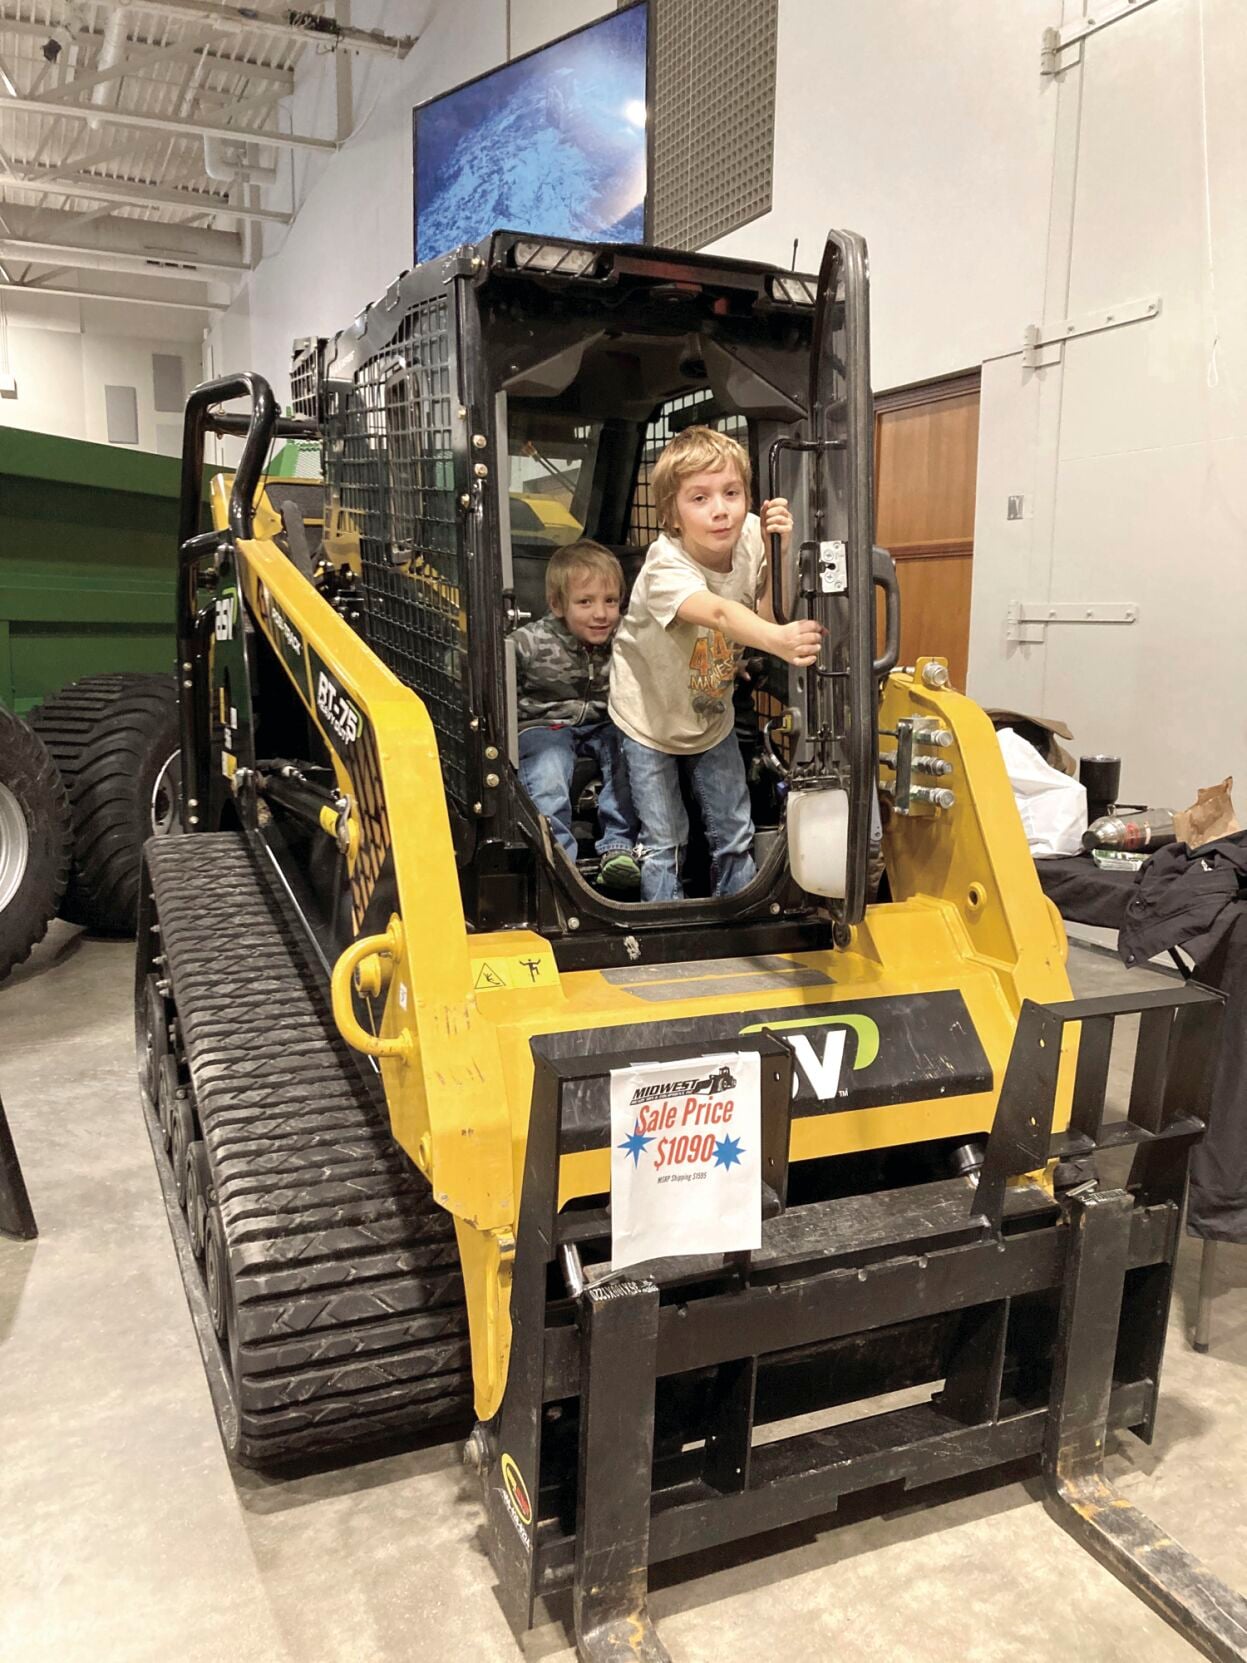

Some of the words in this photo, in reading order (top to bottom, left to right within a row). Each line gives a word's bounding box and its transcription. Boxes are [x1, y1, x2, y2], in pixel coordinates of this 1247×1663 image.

[632, 1078, 700, 1100] MIDWEST
[636, 1102, 678, 1135] Sale
[681, 1096, 734, 1126] Price
[654, 1133, 716, 1171] $1090
[670, 1173, 692, 1183] Shipping
